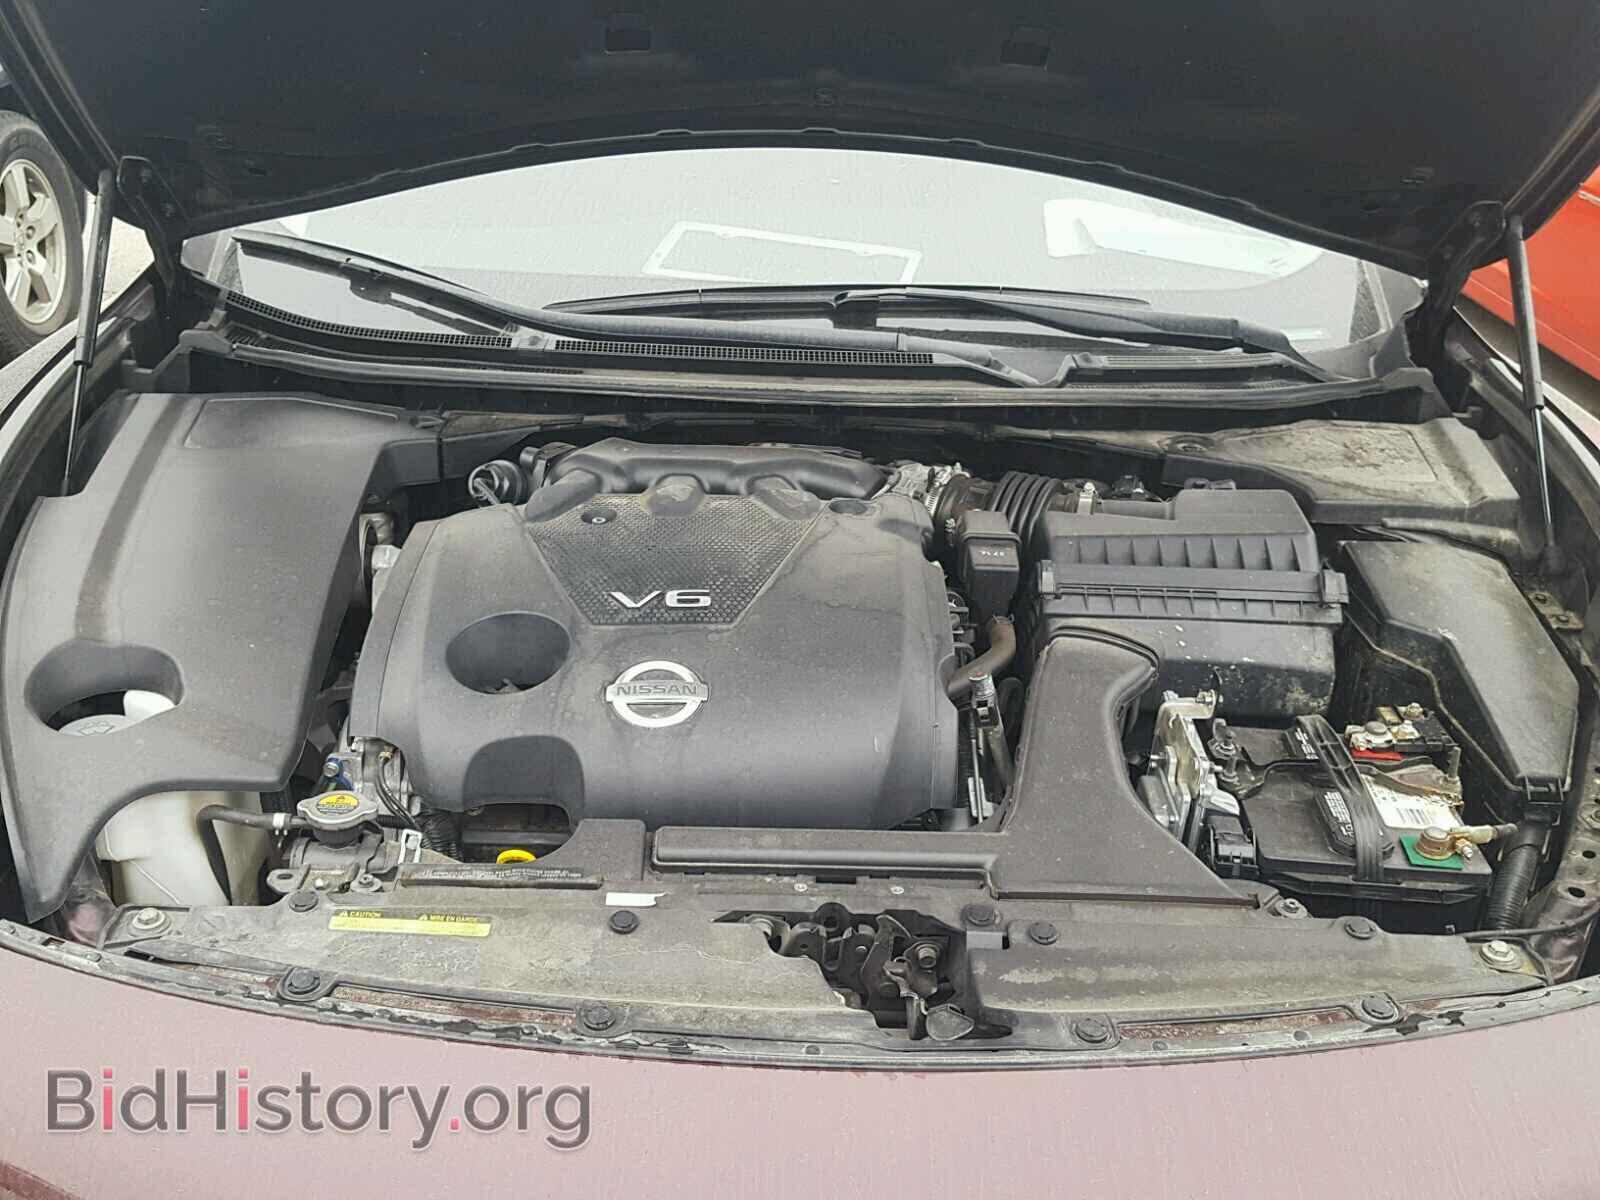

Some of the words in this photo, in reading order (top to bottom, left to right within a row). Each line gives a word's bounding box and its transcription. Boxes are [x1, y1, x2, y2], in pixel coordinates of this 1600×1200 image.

[609, 589, 712, 608] V6
[616, 684, 698, 697] NISSAN
[349, 910, 382, 919] CAUTION
